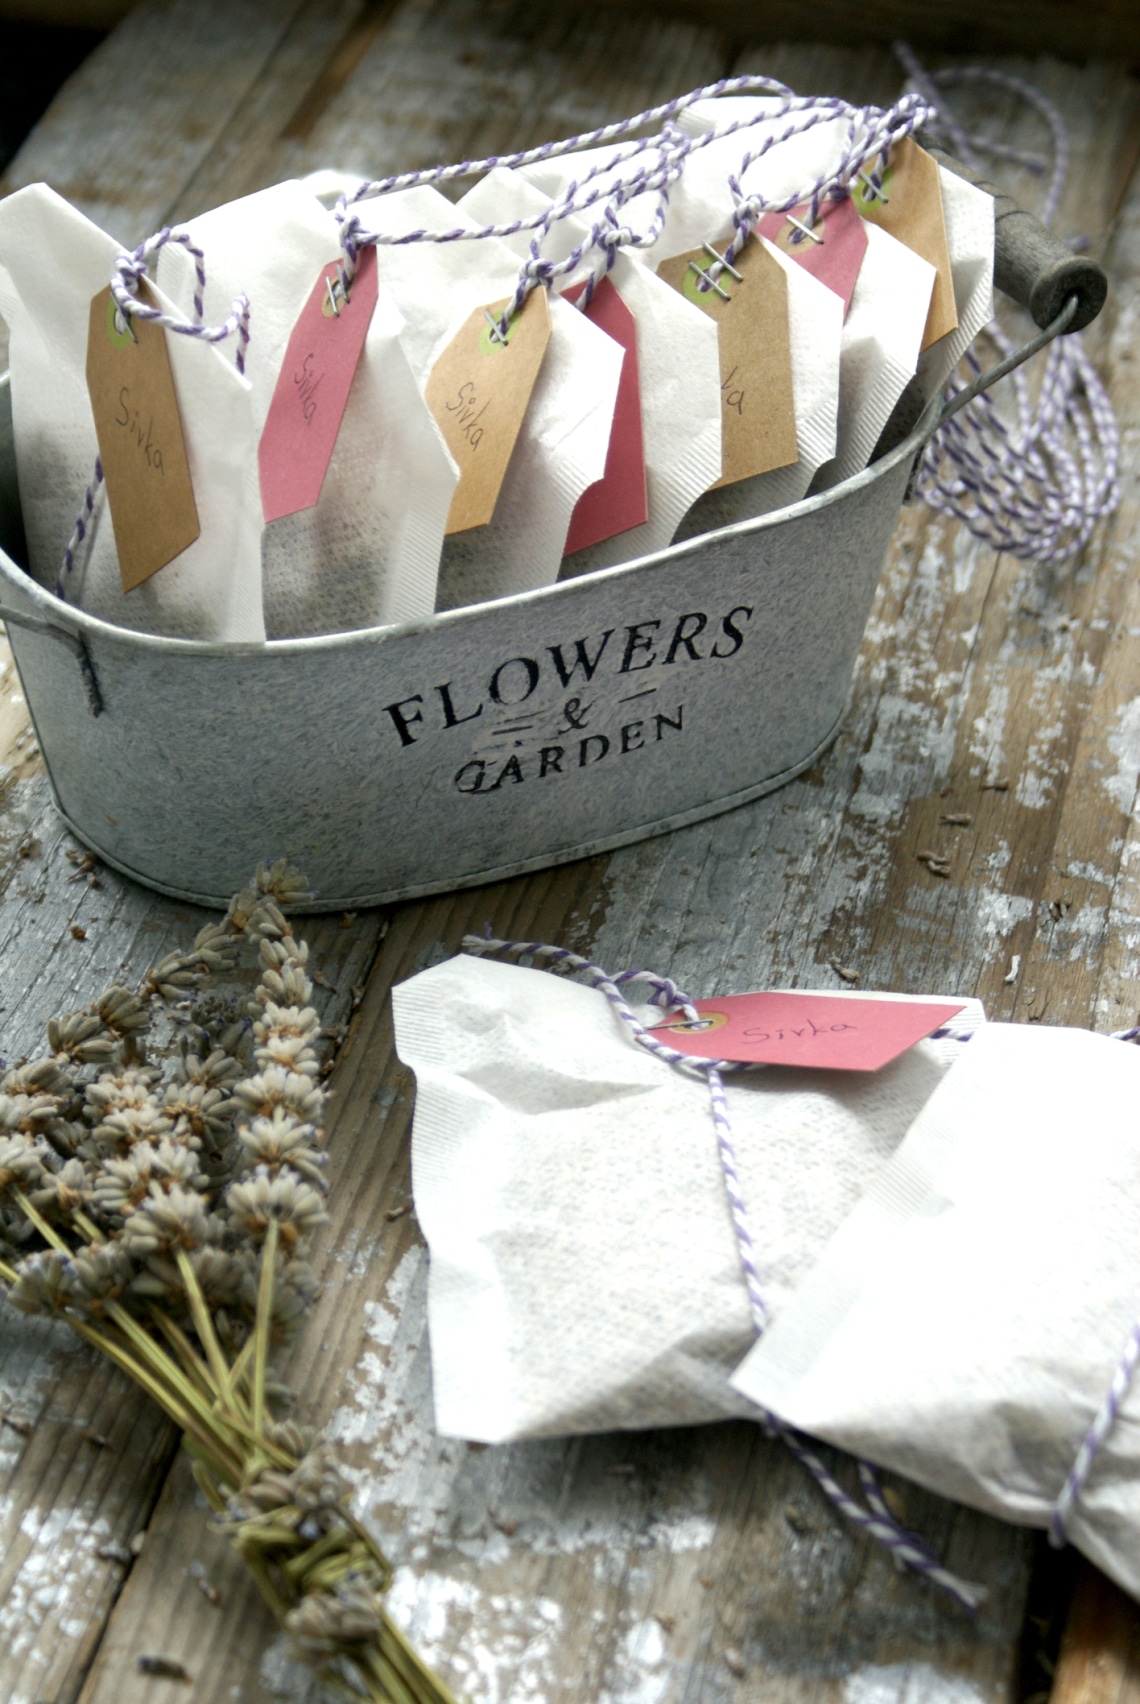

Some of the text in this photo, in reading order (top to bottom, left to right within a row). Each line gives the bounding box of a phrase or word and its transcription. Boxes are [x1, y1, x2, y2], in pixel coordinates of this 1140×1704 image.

[446, 381, 492, 452] Sivka
[382, 606, 754, 747] FLOWERS
[557, 697, 597, 735] &
[453, 704, 684, 794] GARDEN
